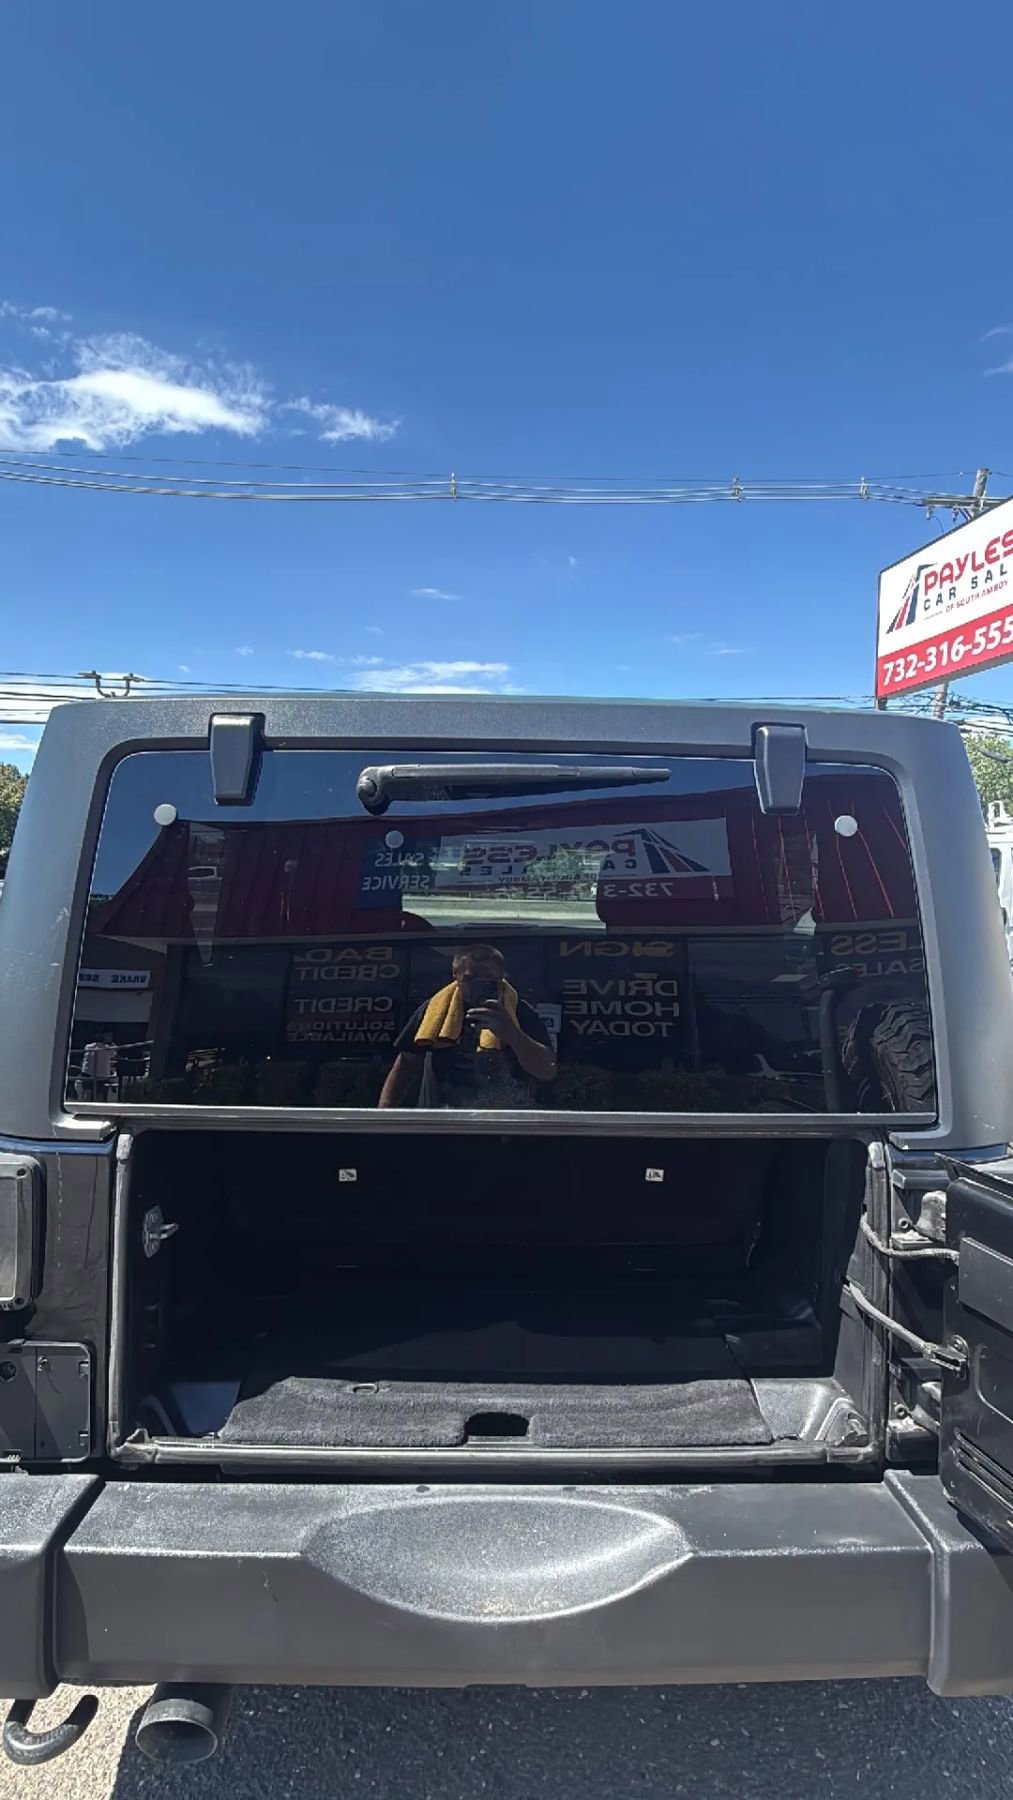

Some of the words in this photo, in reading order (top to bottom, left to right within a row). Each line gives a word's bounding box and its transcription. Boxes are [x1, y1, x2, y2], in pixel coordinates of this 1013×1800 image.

[923, 587, 957, 611] CAR
[971, 563, 1008, 590] SAL
[956, 591, 980, 608] SOUTH
[981, 579, 1009, 596] AMBOY
